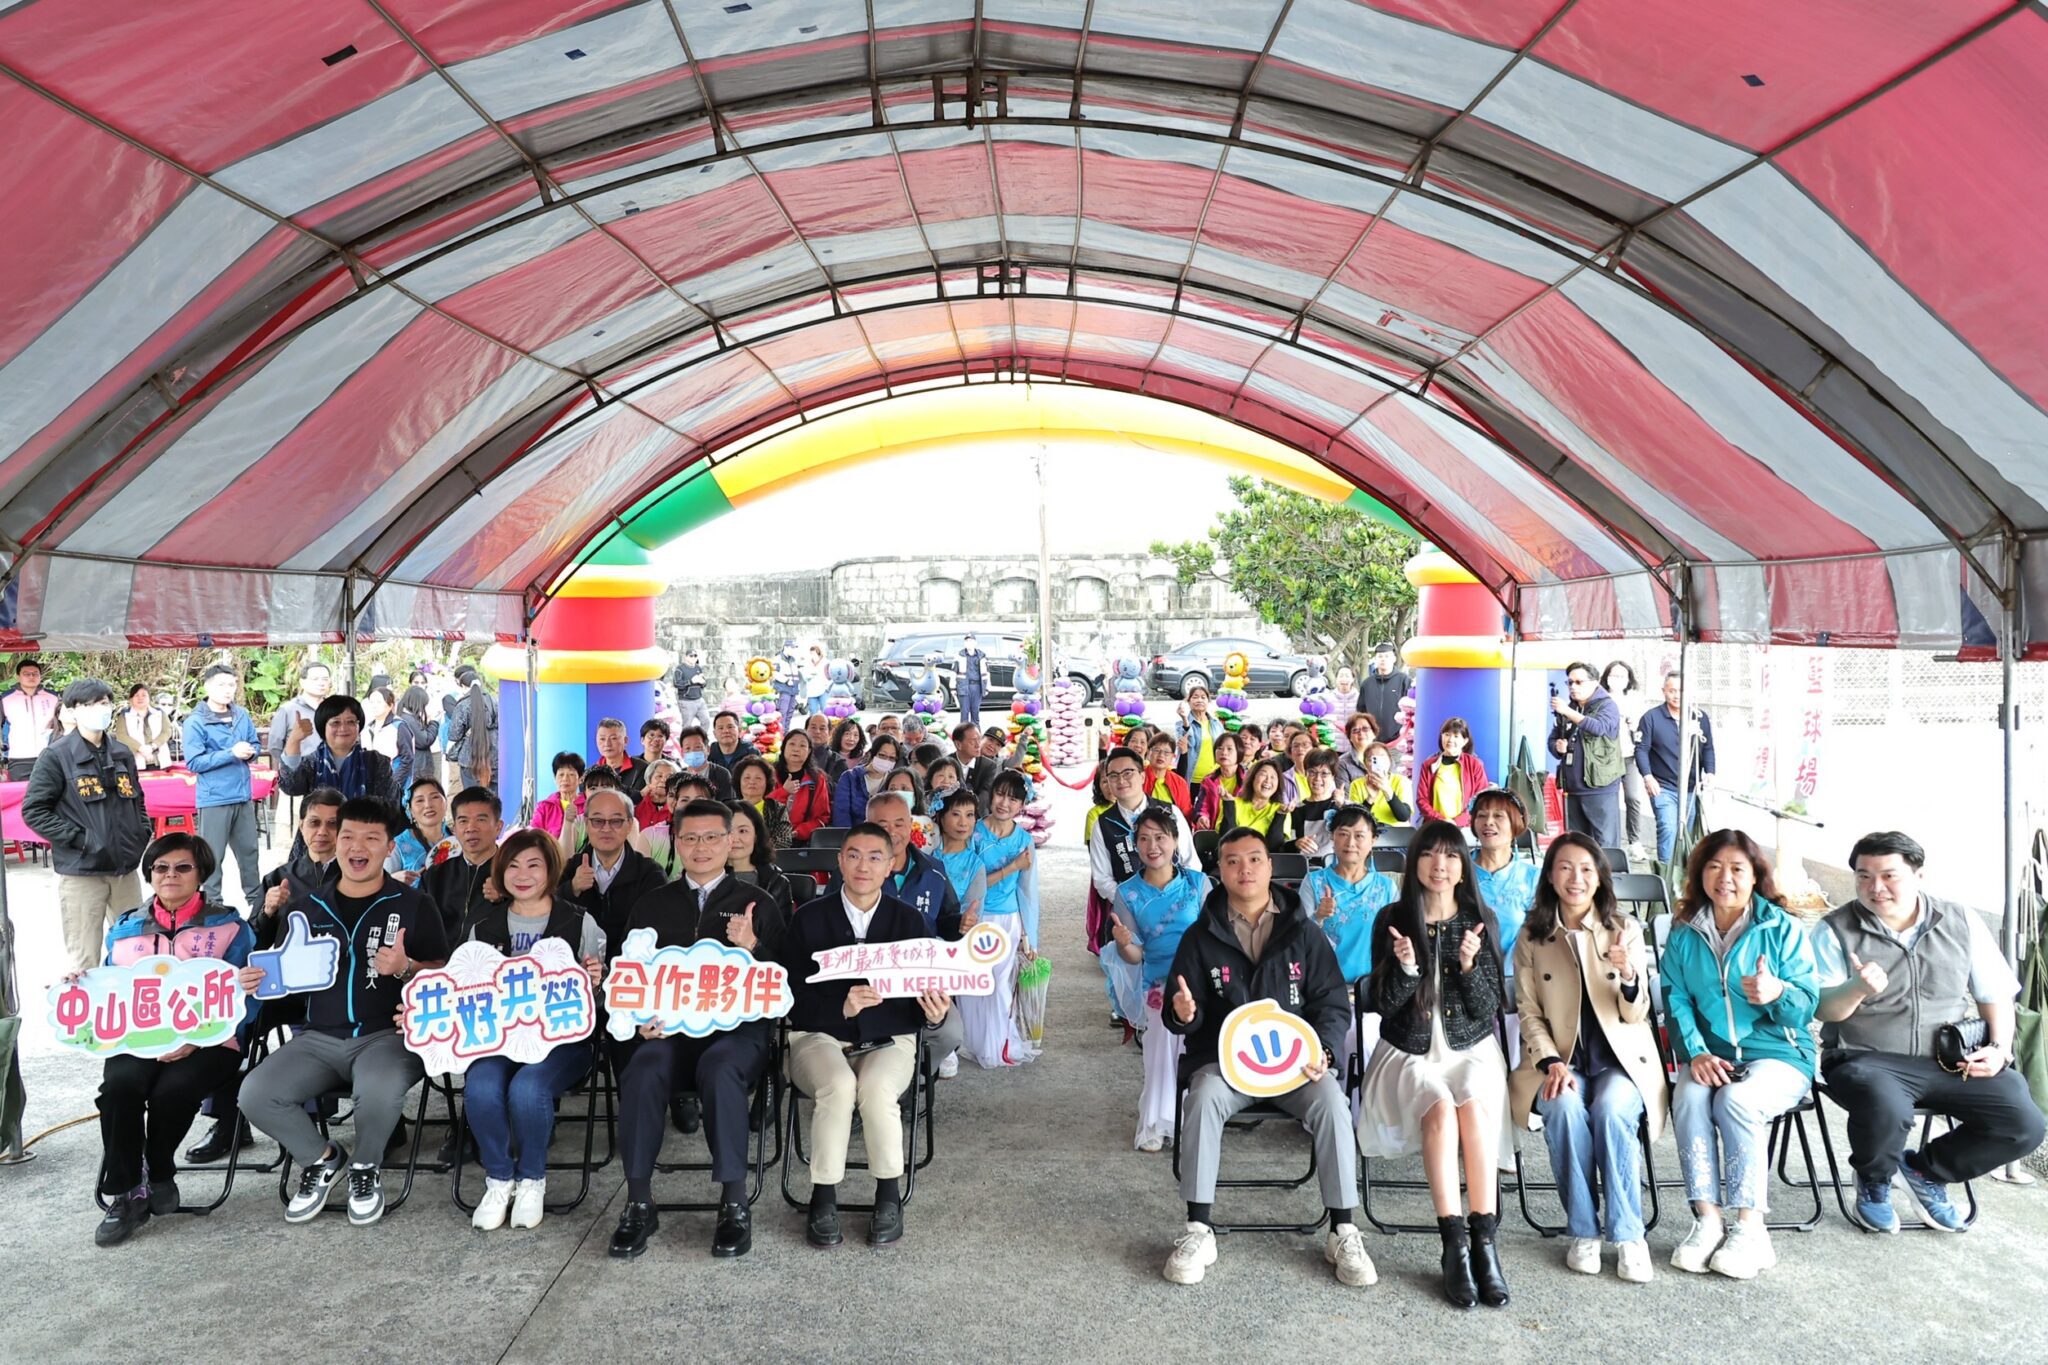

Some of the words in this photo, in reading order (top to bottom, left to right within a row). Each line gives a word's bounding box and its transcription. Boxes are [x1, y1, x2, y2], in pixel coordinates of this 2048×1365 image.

[56, 969, 235, 1040] 中山區公所
[413, 966, 583, 1048] 共好共榮
[609, 962, 783, 1013] 合作夥伴
[903, 974, 990, 992] KEELUNG
